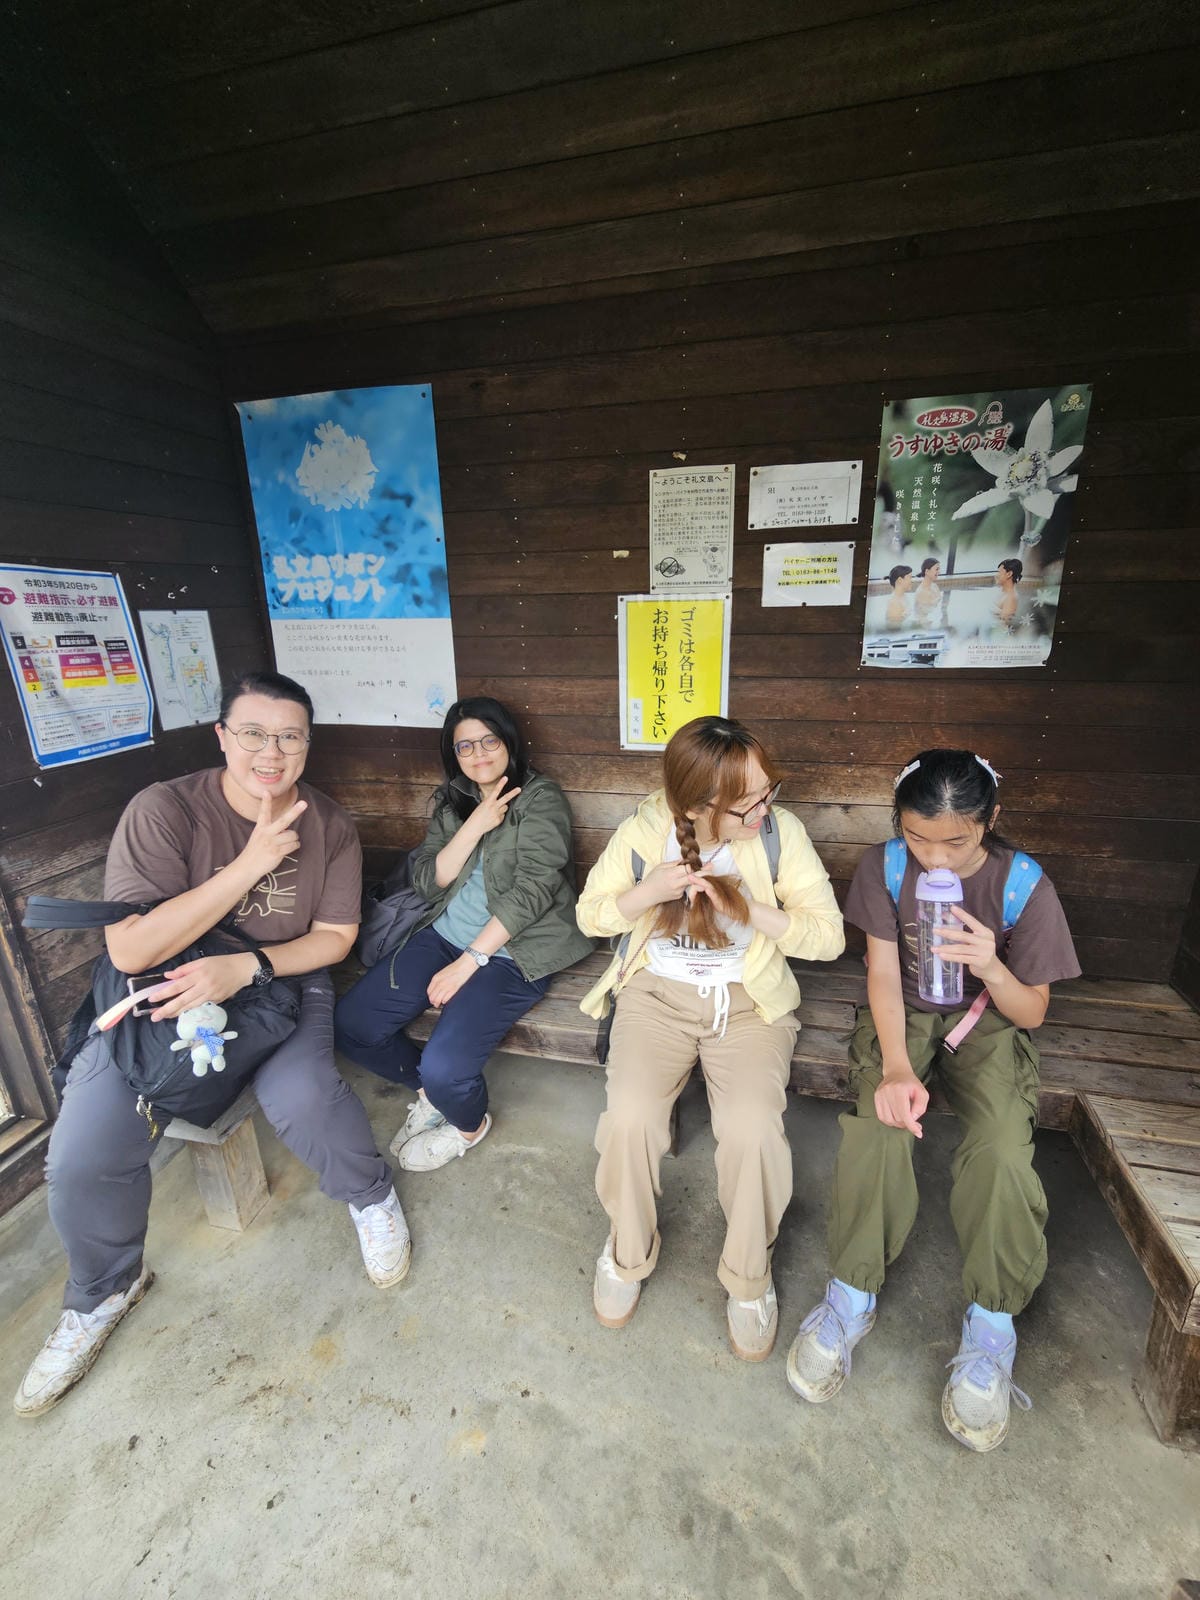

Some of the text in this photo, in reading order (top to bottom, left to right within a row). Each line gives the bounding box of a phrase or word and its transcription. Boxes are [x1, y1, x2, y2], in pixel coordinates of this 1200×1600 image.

[921, 411, 969, 425] 礼文島温泉
[890, 428, 1007, 458] うすゆきの湯
[910, 476, 923, 532] 天然温泉も
[927, 463, 943, 537] 花咲く礼文に、
[892, 489, 905, 545] 咲きました
[23, 579, 98, 591] 令和3年5月20日から
[23, 592, 119, 607] 避難指示で必ず避難
[678, 606, 697, 703] ゴミは各自で
[28, 672, 34, 680] 3
[32, 683, 37, 691] 2
[652, 608, 669, 739] お持ち帰り下さい
